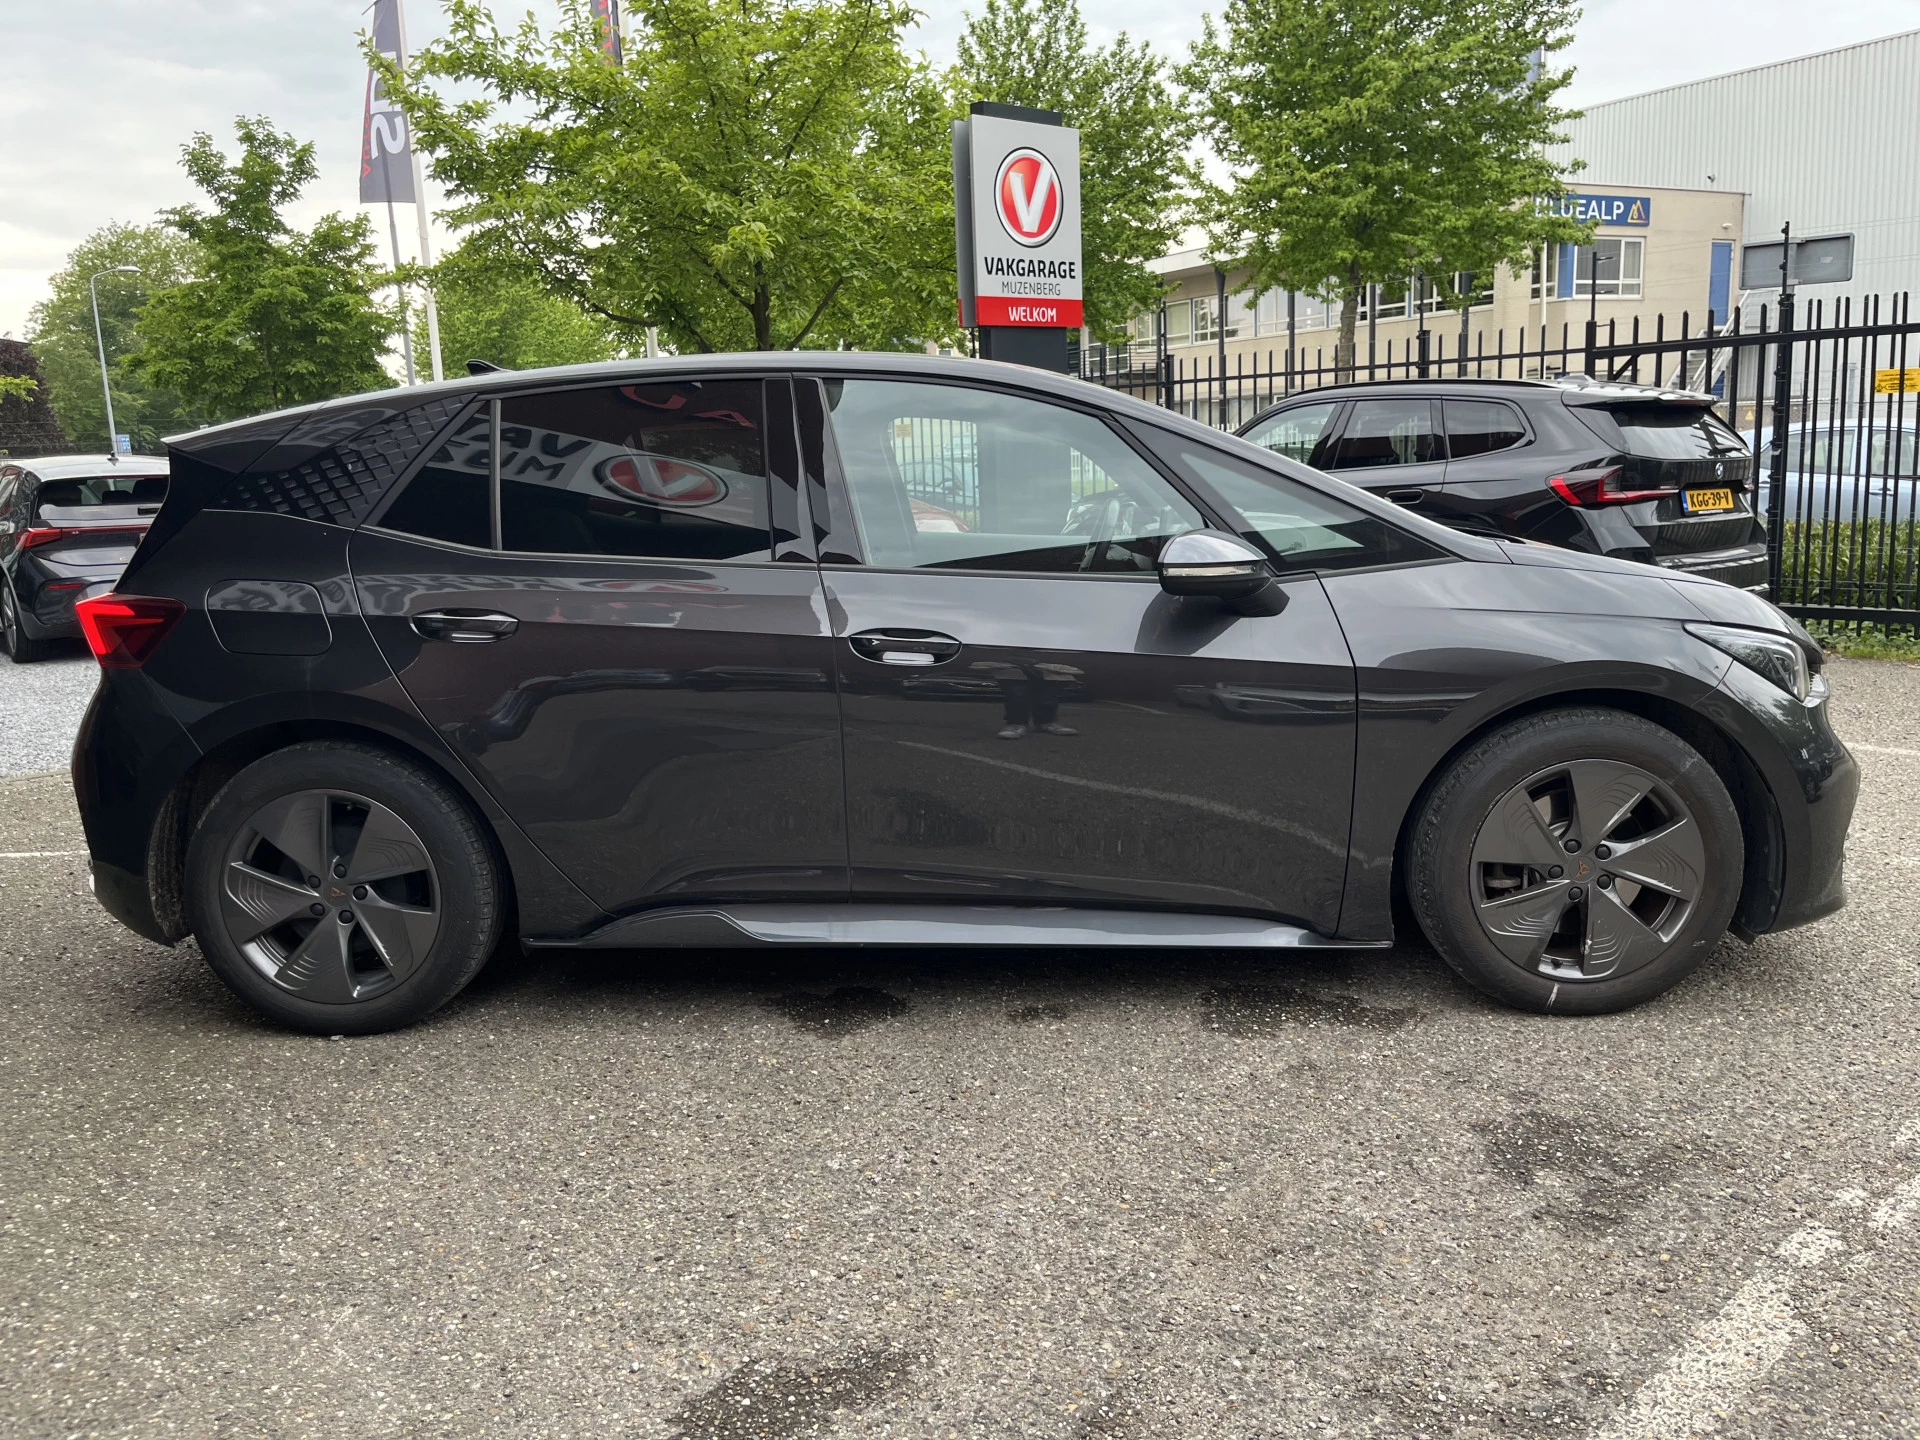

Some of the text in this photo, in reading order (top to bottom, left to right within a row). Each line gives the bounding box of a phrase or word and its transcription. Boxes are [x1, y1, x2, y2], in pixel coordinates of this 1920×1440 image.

[984, 256, 1076, 280] VAKGARAGE
[1001, 281, 1061, 296] MUZENBERG
[1008, 306, 1057, 323] WELKOM
[1689, 491, 1730, 508] KGG-39-V
